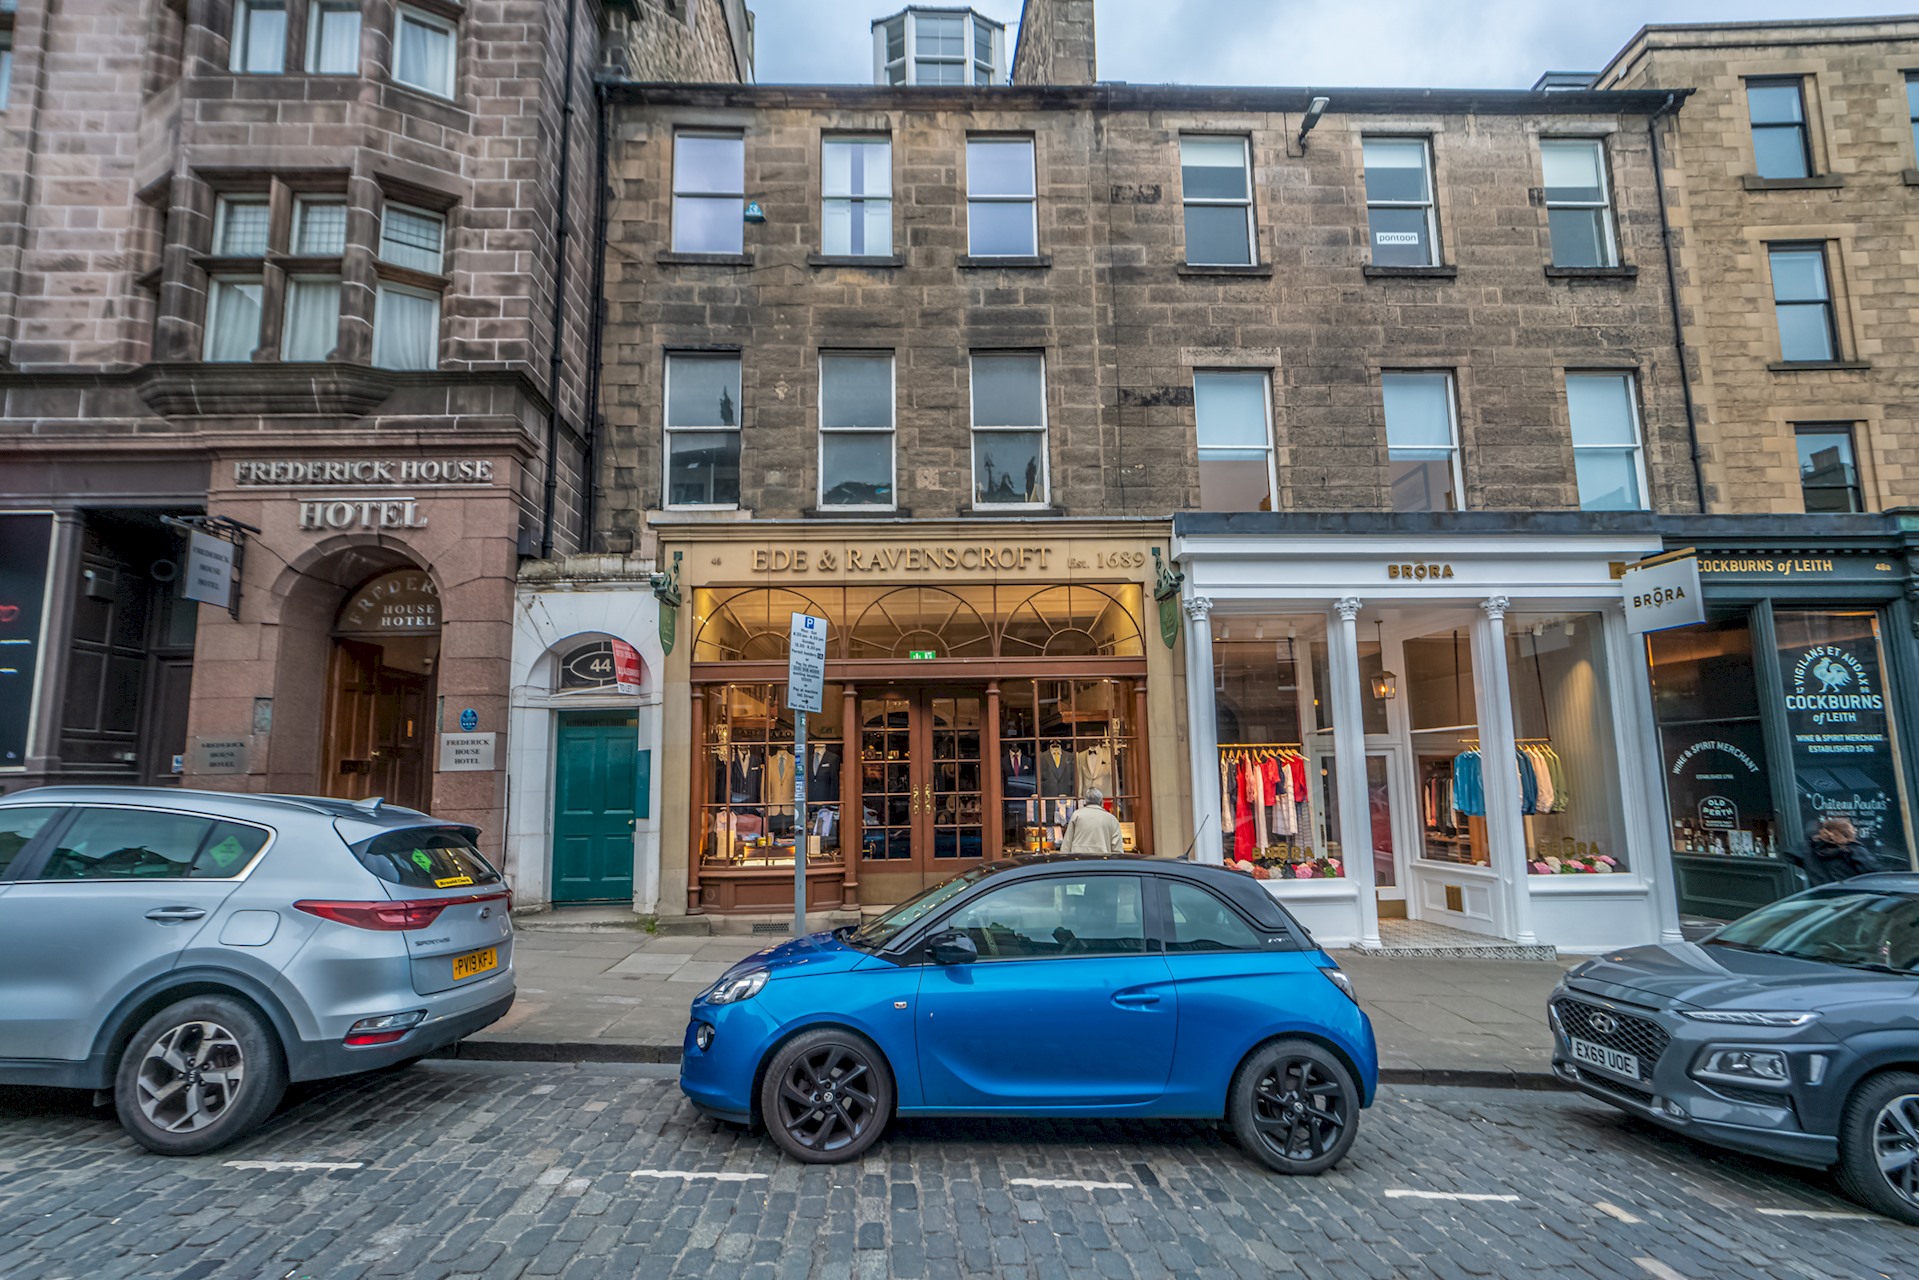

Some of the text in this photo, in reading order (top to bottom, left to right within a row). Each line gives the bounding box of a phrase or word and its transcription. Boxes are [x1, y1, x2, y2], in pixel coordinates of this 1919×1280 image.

[1379, 234, 1417, 242] pontoon
[233, 459, 494, 482] FREDERICK HOUSE
[299, 500, 429, 528] HOTEL
[751, 545, 1146, 572] EDE & RAVENSCROFT Est. 1689
[1777, 559, 1793, 576] of
[1794, 559, 1833, 572] LEITH
[383, 604, 435, 614] HOUSE
[381, 616, 436, 626] HOTEL
[589, 658, 612, 673] 44
[1793, 646, 1825, 686] VIGILANS
[1826, 645, 1842, 657] ET
[1841, 652, 1870, 686] AUDAX
[1785, 694, 1883, 710] COCKBURNS
[1812, 712, 1857, 725] of LEITH
[1795, 734, 1815, 742] WINE
[1822, 734, 1844, 742] SPIRIT
[1844, 734, 1883, 742] MERCHANT
[1808, 745, 1856, 753] ESTABLISHED
[1672, 754, 1688, 775] WINE
[1690, 740, 1716, 754] SPIRIT
[1716, 741, 1760, 773] MERCHANT
[1707, 799, 1726, 807] OLD
[1702, 806, 1734, 817] PERTH
[458, 949, 493, 975] PV19 KFJ
[1576, 1041, 1632, 1074] EX69 UOE
